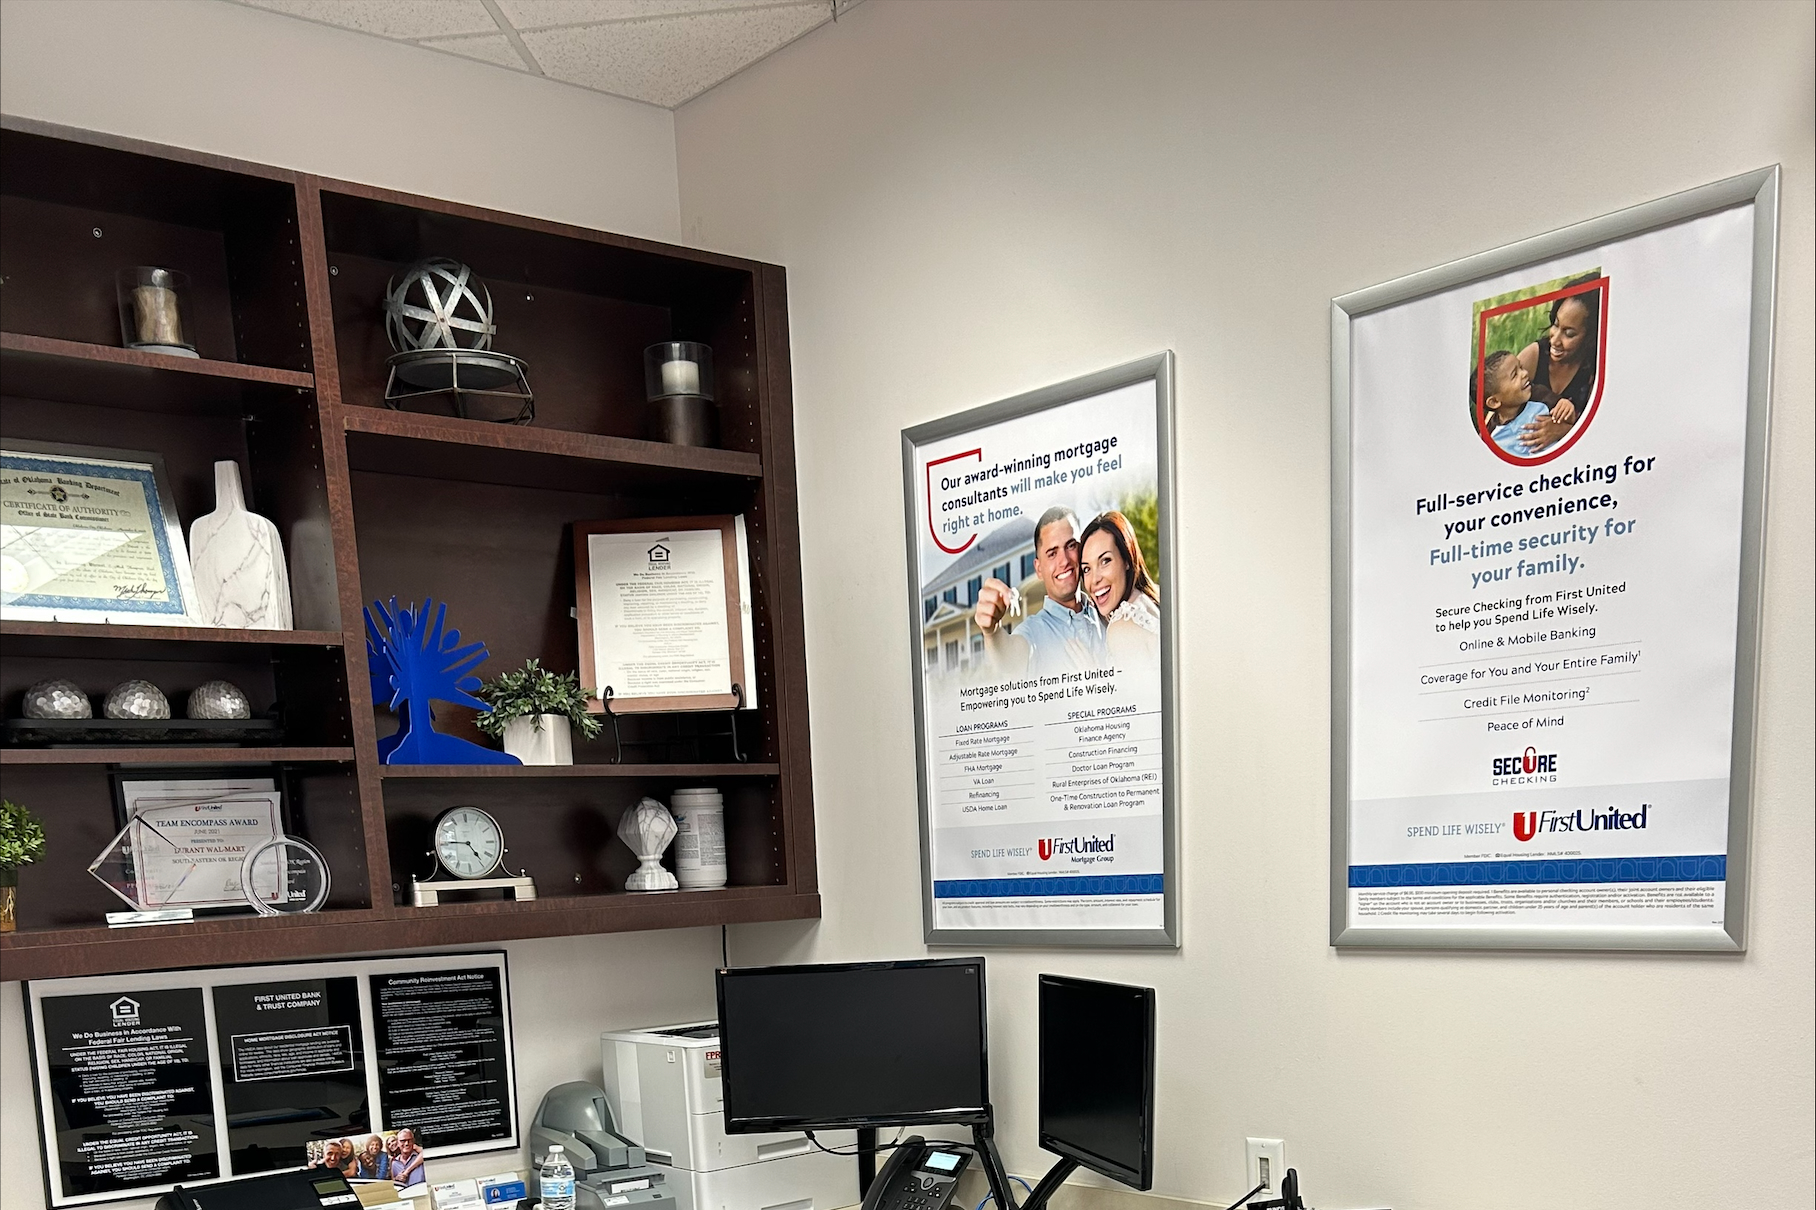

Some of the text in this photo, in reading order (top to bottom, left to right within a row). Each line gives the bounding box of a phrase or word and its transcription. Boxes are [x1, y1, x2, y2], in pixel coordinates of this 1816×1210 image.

[941, 437, 1117, 491] Our award-winning mortgage
[942, 454, 1121, 512] consultants will make you feel
[1416, 455, 1656, 515] Full-service checking for
[3, 501, 57, 511] CERTIFICATE
[72, 506, 119, 516] AUTHORITY
[943, 506, 1023, 534] right at home.
[1444, 493, 1618, 540] your convenience,
[1430, 518, 1636, 565] Full-time security for
[1471, 554, 1585, 589] your family.
[1435, 582, 1626, 618] Secure Checking from First United
[1435, 602, 1598, 633] to help you Spend Life Wisely.
[1460, 626, 1596, 651] Online & Mobile Banking
[1420, 670, 1468, 685] Coverage
[1471, 668, 1486, 679] for
[1489, 666, 1508, 677] You
[1511, 663, 1531, 674] and
[1534, 660, 1560, 673] Your
[1563, 657, 1597, 669] Entire
[960, 667, 1115, 697] Mortgage solutions from First United
[961, 683, 1117, 712] Empowering you to Spend Life Wisely.
[1464, 697, 1498, 709] Credit
[1500, 695, 1520, 706] File
[1068, 705, 1137, 720] SPECIAL PROGRAMS
[956, 720, 1008, 733] LOAN PROGRAMS
[1074, 721, 1130, 733] Oklahoma Housing
[1487, 716, 1564, 732] Peace of Mind
[956, 734, 1010, 747] Fixed Rate Mortgage
[1079, 732, 1126, 743] Finance Agency
[949, 748, 1018, 762] Adjustable Rate Mortgage
[1069, 746, 1138, 758] Construction Financing
[977, 763, 1003, 772] Mortgage
[1093, 763, 1108, 771] Loan
[1109, 760, 1135, 770] Program
[1493, 751, 1557, 776] SECURE
[982, 777, 995, 785] Loan
[1068, 777, 1101, 788] Enterprises
[1110, 773, 1140, 783] Oklahoma
[1142, 773, 1158, 782] (REI)
[1492, 775, 1557, 786] CHECKING
[969, 791, 1000, 800] Refinancing
[1079, 792, 1117, 800] Construction
[1126, 788, 1160, 796] Permanent
[962, 805, 977, 813] USDA
[1070, 802, 1102, 810] Renovation
[1103, 800, 1118, 808] Loan
[1119, 799, 1145, 808] Program
[1407, 826, 1439, 837] SPEND
[1442, 825, 1461, 836] LIFE
[971, 849, 991, 859] SPEND
[993, 848, 1005, 858] LIFE
[1071, 855, 1114, 864] Mortgage Group
[287, 1000, 320, 1008] COMPANY
[131, 1027, 166, 1035] Accordance
